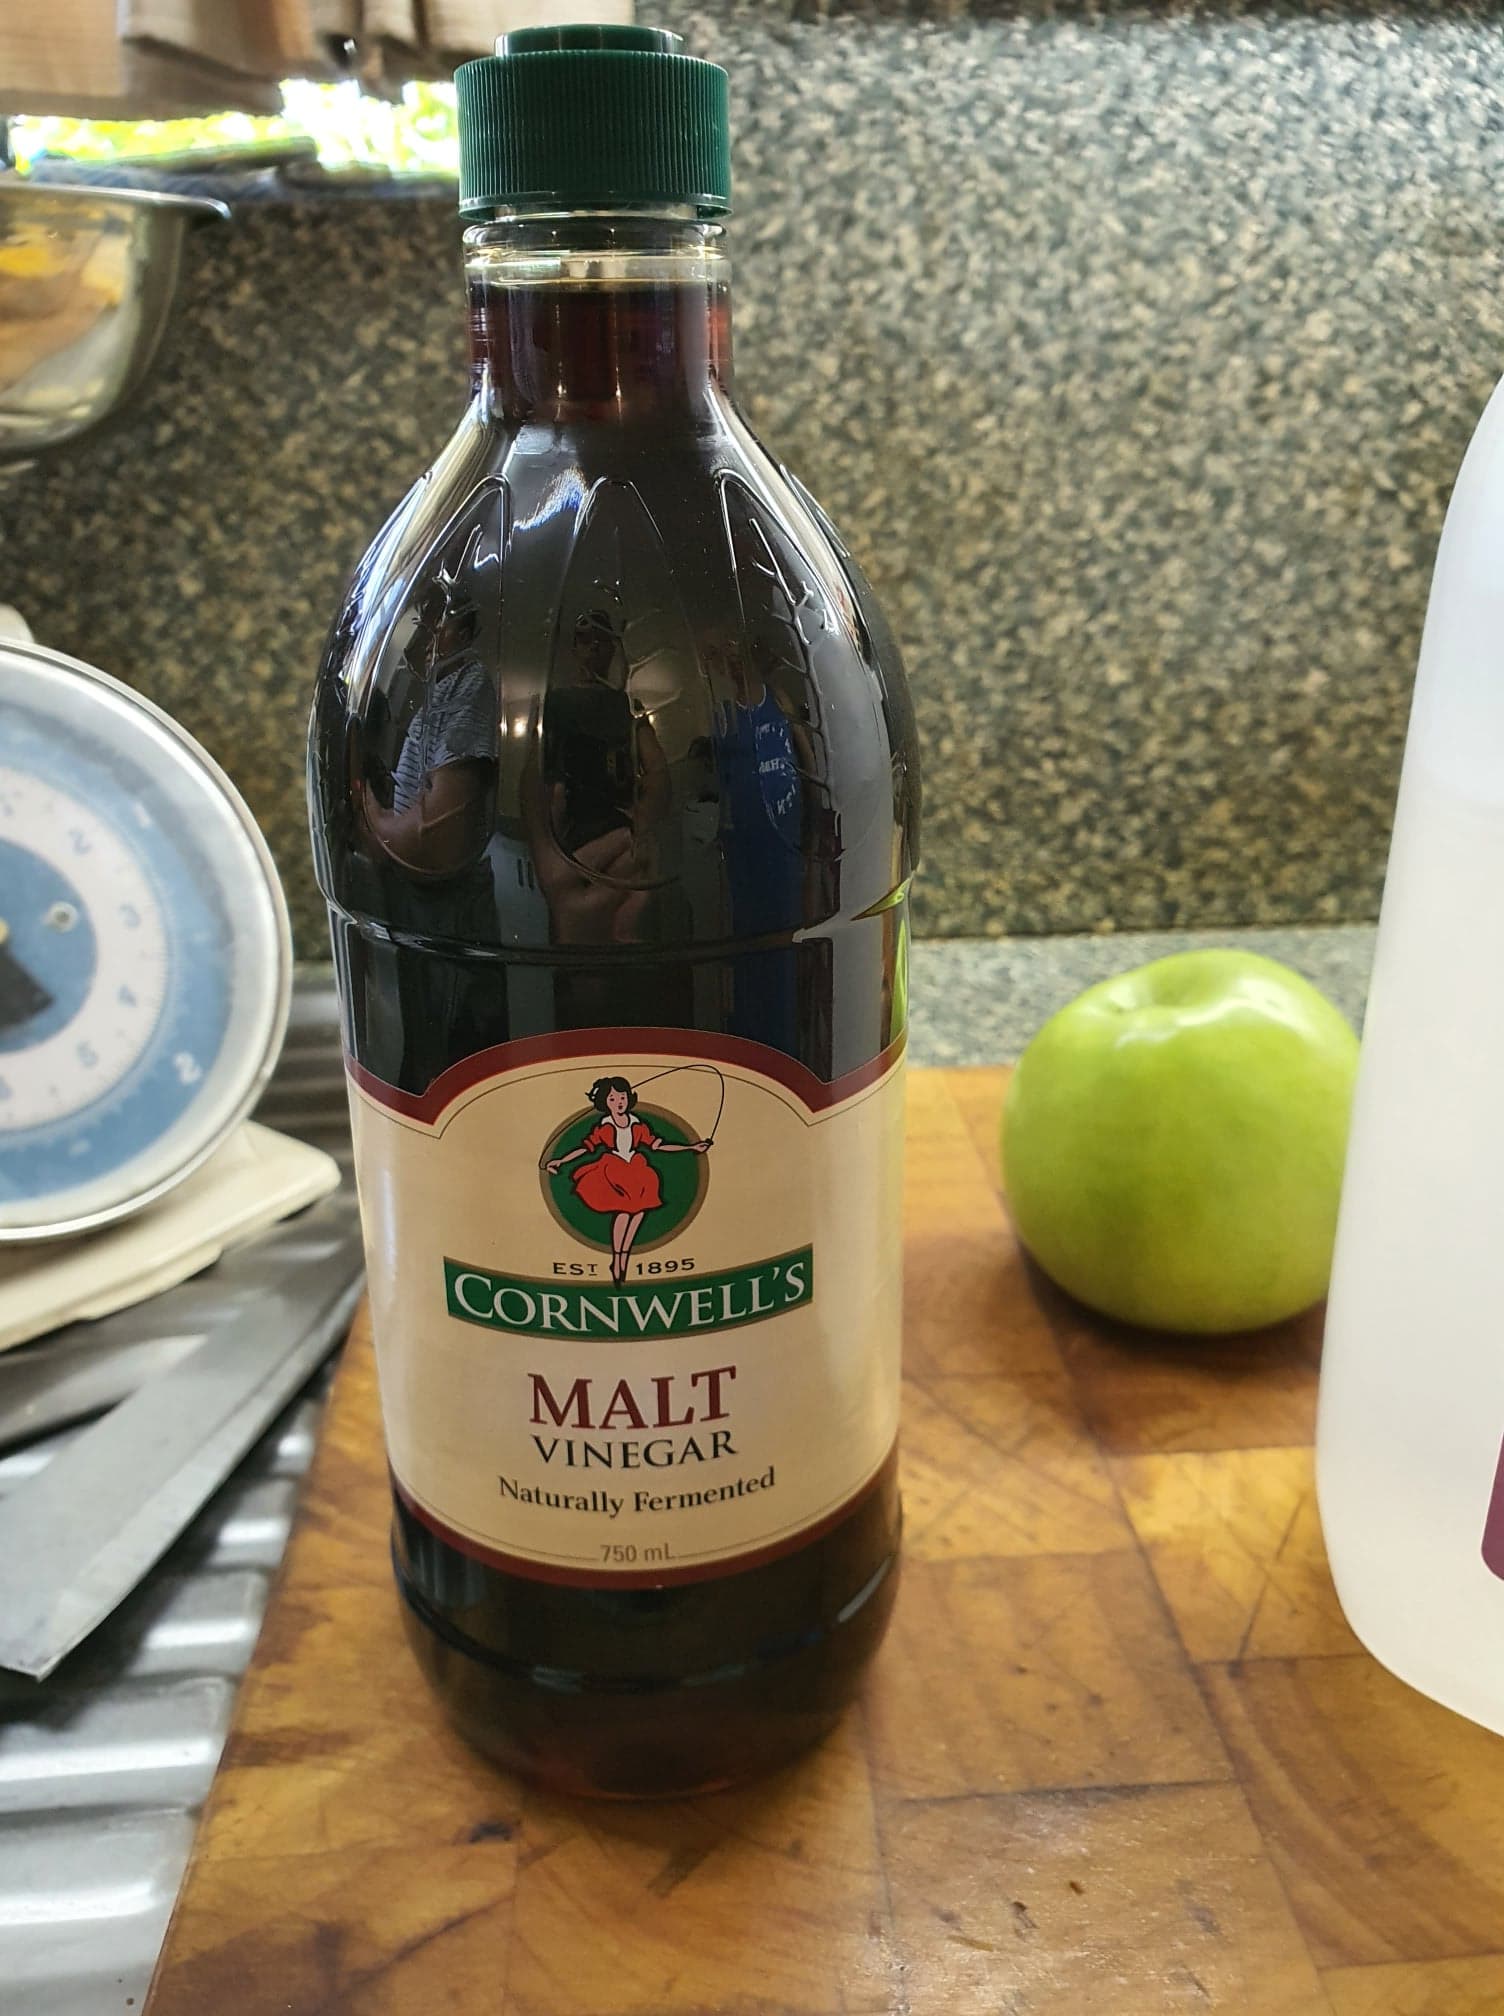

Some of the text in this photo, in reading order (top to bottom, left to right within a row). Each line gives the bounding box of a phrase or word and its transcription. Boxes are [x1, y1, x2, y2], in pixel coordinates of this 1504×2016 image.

[172, 1050, 203, 1086] 2
[636, 1257, 696, 1276] 1895
[454, 1261, 806, 1333] CORNWELL'S
[527, 1365, 737, 1430] MALT
[532, 1429, 739, 1470] VINEGAR
[498, 1466, 776, 1519] Naturally Fermented
[600, 1543, 673, 1562] 750 mL
